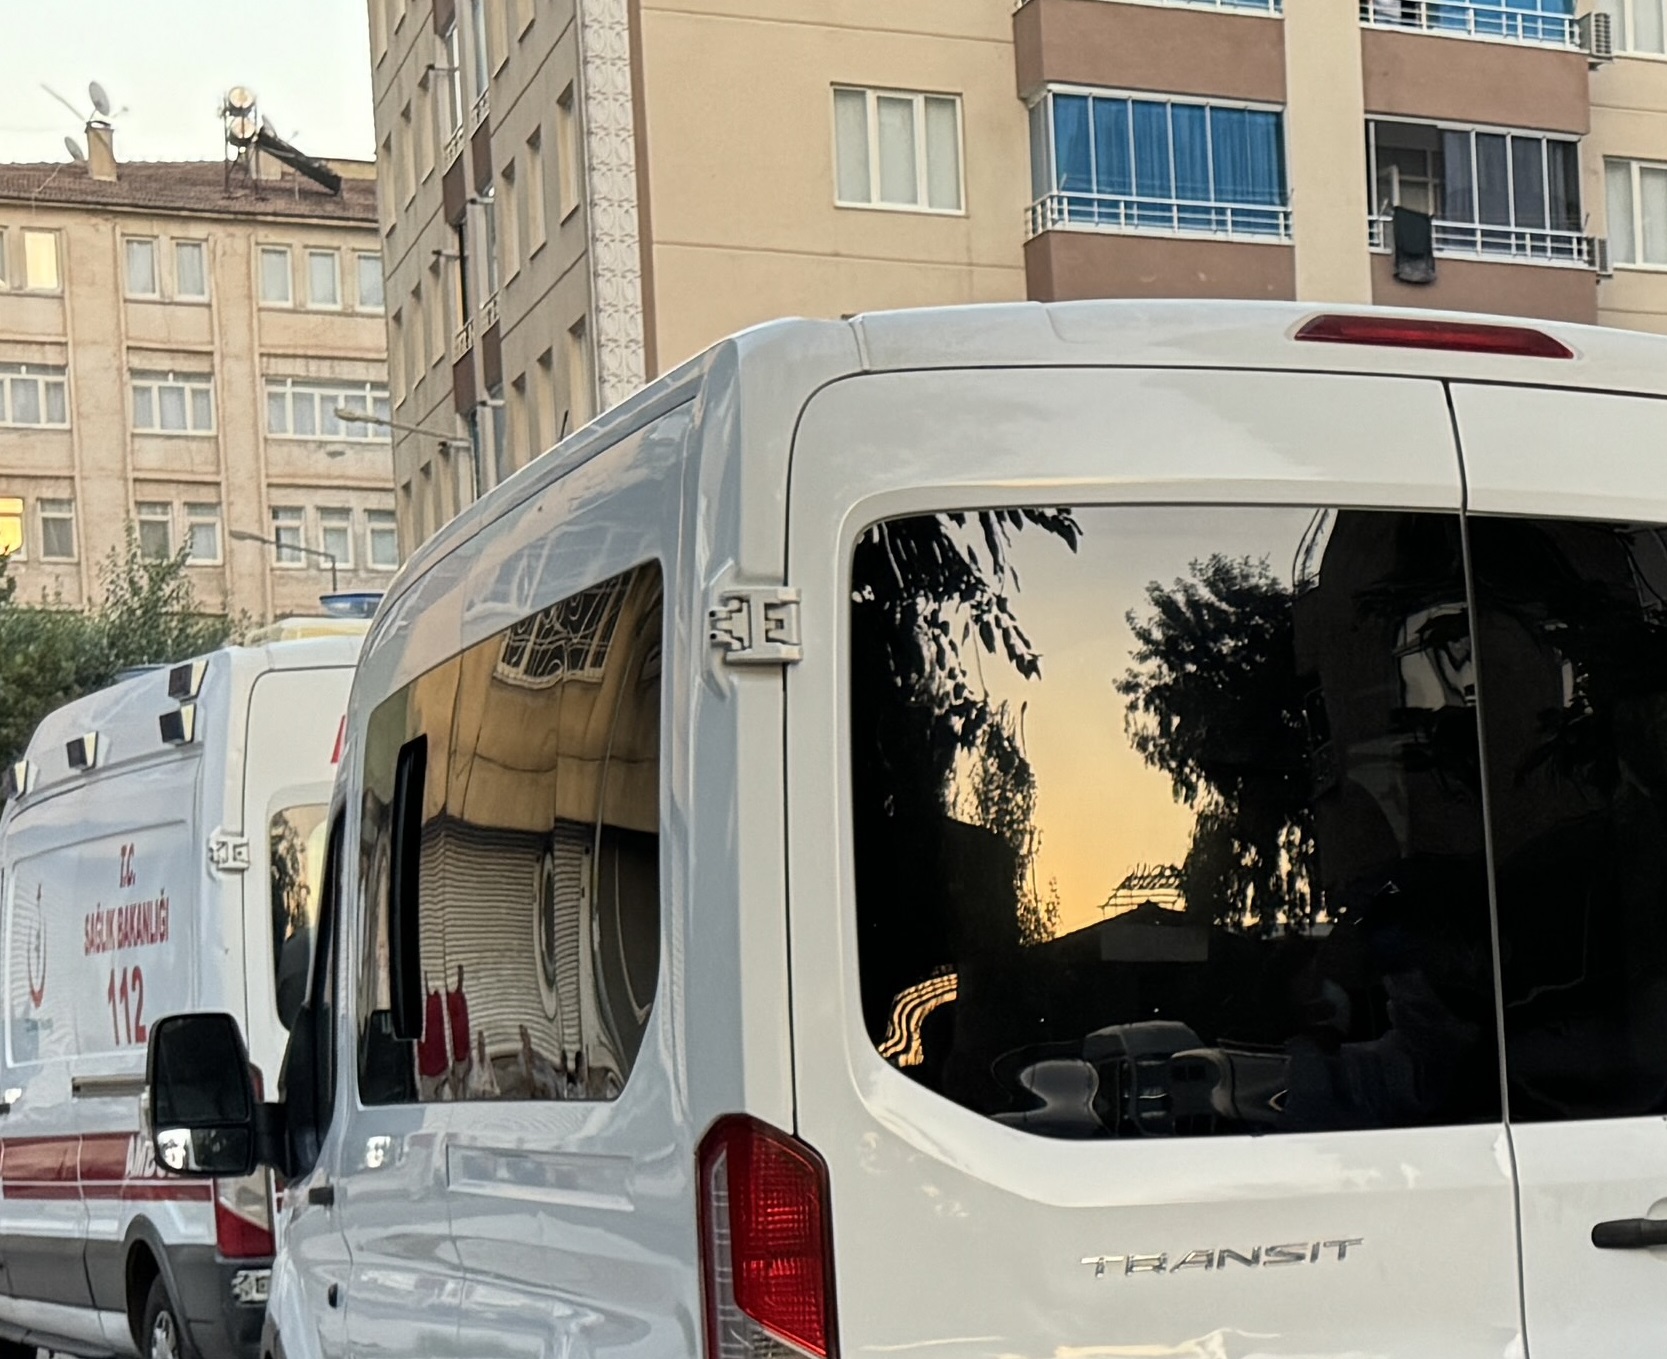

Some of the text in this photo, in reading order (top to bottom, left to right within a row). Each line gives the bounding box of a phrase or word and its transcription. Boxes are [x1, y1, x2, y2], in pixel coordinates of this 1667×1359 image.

[84, 887, 169, 956] SAĞLIK BAKANLIĞI
[107, 965, 147, 1046] 112
[1080, 1237, 1364, 1278] TRANSIT
